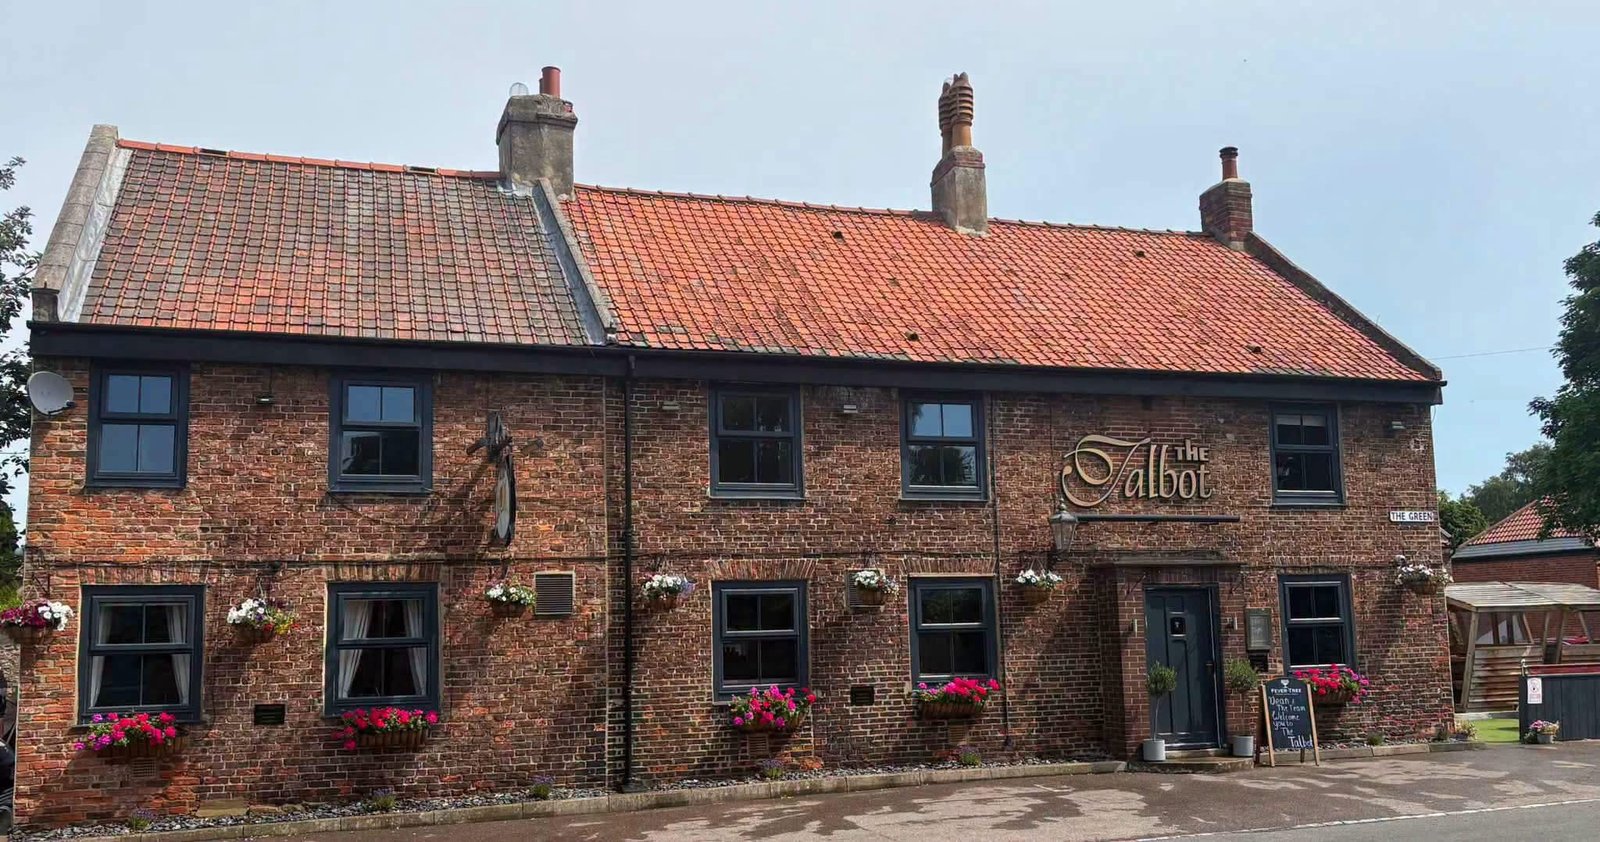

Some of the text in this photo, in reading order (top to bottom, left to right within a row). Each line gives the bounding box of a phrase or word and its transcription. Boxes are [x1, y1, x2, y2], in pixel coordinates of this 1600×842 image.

[1062, 434, 1213, 507] Talbot
[1391, 512, 1433, 520] THE GREEN
[1289, 704, 1306, 712] Team
[1272, 710, 1300, 721] Welcome
[1281, 726, 1294, 736] The
